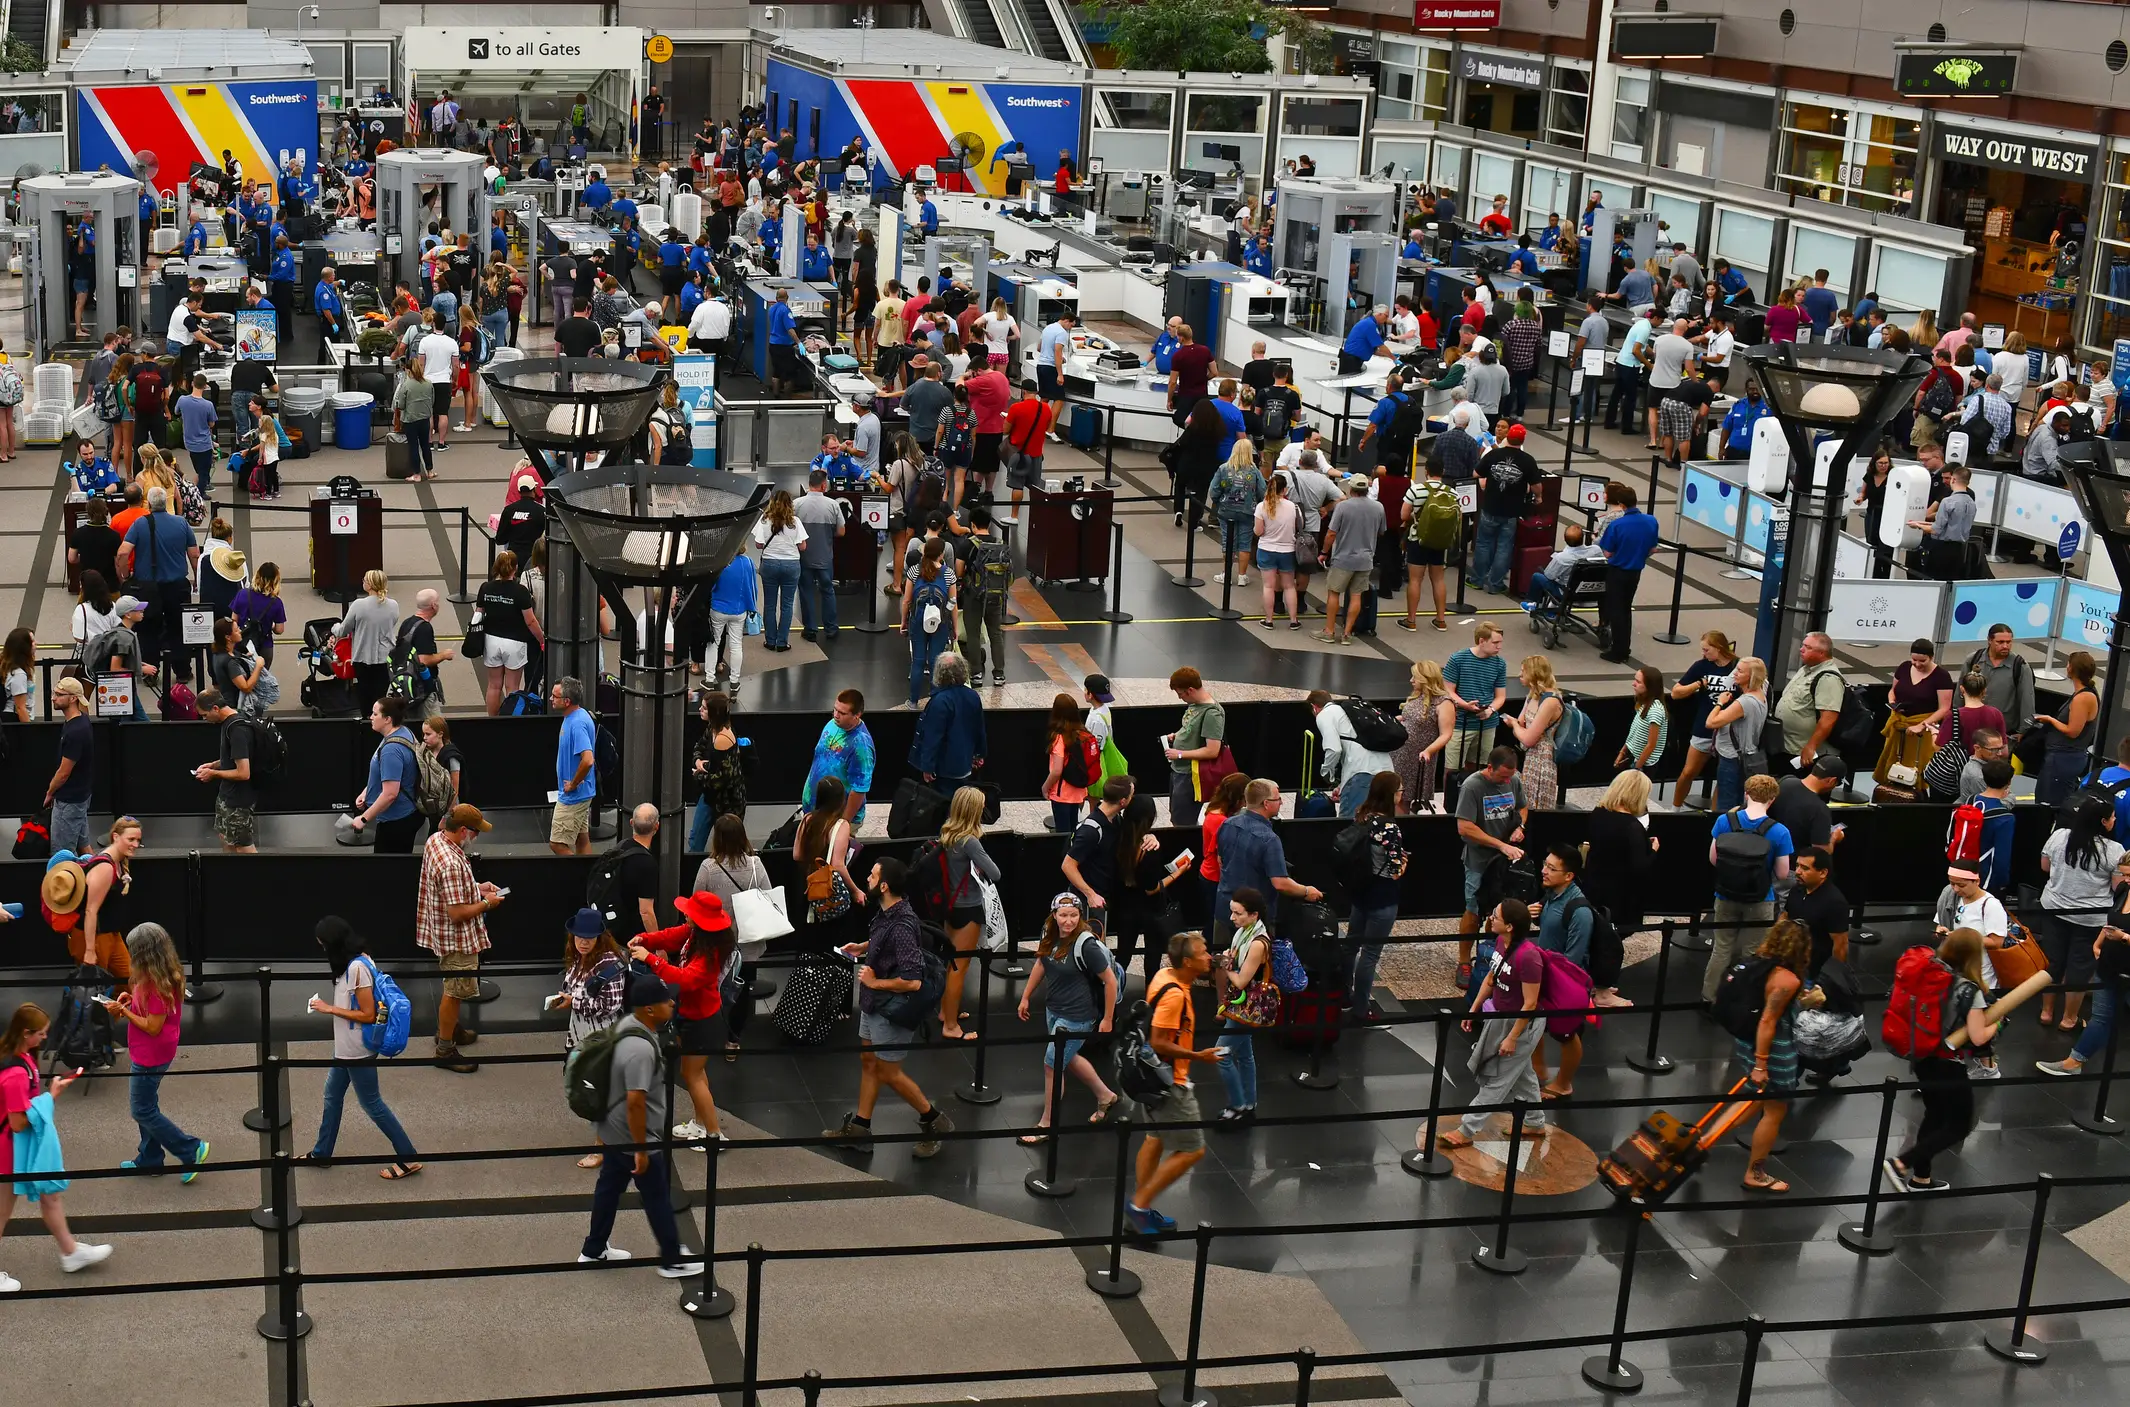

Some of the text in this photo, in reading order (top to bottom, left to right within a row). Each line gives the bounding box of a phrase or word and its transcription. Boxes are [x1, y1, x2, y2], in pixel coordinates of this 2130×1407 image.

[1434, 10, 1452, 18] Rocky
[1453, 10, 1480, 18] Mountain
[495, 42, 580, 56] to all Gates
[1478, 60, 1498, 80] Rocky
[1497, 64, 1525, 82] Mountain
[1932, 58, 1956, 74] WAY
[1961, 58, 1984, 74] WEST
[250, 94, 301, 104] Southwest
[1007, 96, 1062, 107] Southwest
[1945, 134, 2088, 174] WAY OUT WEST
[523, 200, 530, 209] 6
[512, 511, 530, 520] NIKE
[2080, 602, 2110, 618] You'r
[1856, 619, 1896, 628] CLEAR
[2084, 619, 2100, 631] ID
